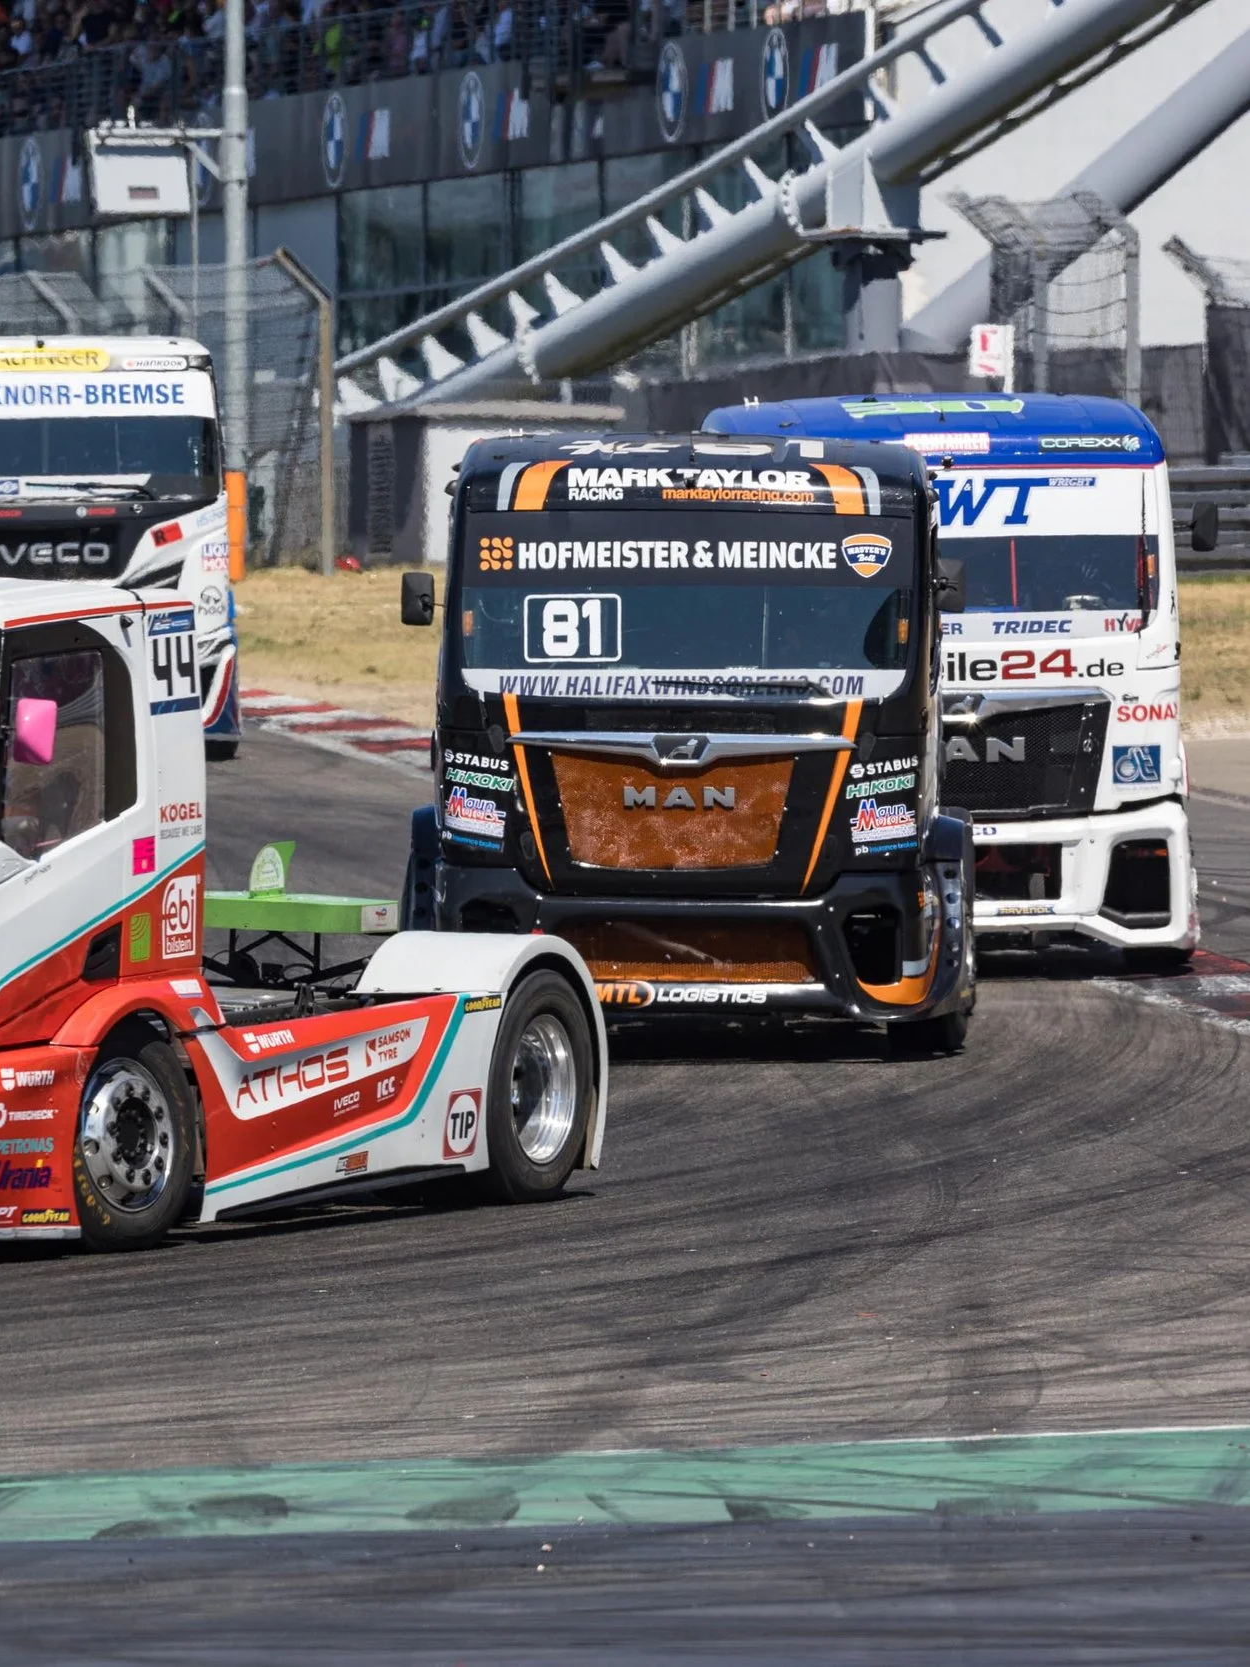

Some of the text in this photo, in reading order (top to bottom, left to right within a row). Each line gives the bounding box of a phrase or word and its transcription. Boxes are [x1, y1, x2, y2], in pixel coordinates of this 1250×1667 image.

[1041, 436, 1121, 449] COREXX
[568, 468, 811, 488] MARK TAYLOR
[1049, 477, 1092, 486] WRIGHT
[569, 488, 623, 500] RACING
[662, 488, 814, 502] marktaylorracing.com
[518, 541, 837, 570] HOFMEISTER & MEINCKE
[543, 599, 601, 656] 81
[993, 619, 1072, 634] TRIDEC
[153, 634, 196, 697] 44
[941, 649, 1125, 681] ile24.de
[500, 675, 863, 696] WWW.HALIFAXWINDSCREENSCOM
[945, 736, 1026, 763] AN
[455, 752, 509, 771] STABUS
[866, 756, 919, 775] STABUS
[623, 786, 735, 810] MAN
[160, 824, 203, 840] BECAUSE WE CARE
[166, 935, 192, 953] bilstein
[465, 997, 501, 1011] GOODYEAR
[657, 988, 767, 1004] LOGISTICS
[256, 1028, 295, 1049] WÜRTH
[377, 1028, 412, 1048] SAMSON
[377, 1048, 399, 1064] TYRE
[15, 1069, 55, 1087] WÜRTH
[237, 1046, 350, 1109] ATHOS
[377, 1076, 395, 1099] ICC
[333, 1090, 360, 1111] IVECO
[8, 1109, 55, 1121] TIRECHECK
[450, 1110, 476, 1140] TIP
[21, 1210, 70, 1224] GOODYEAR
